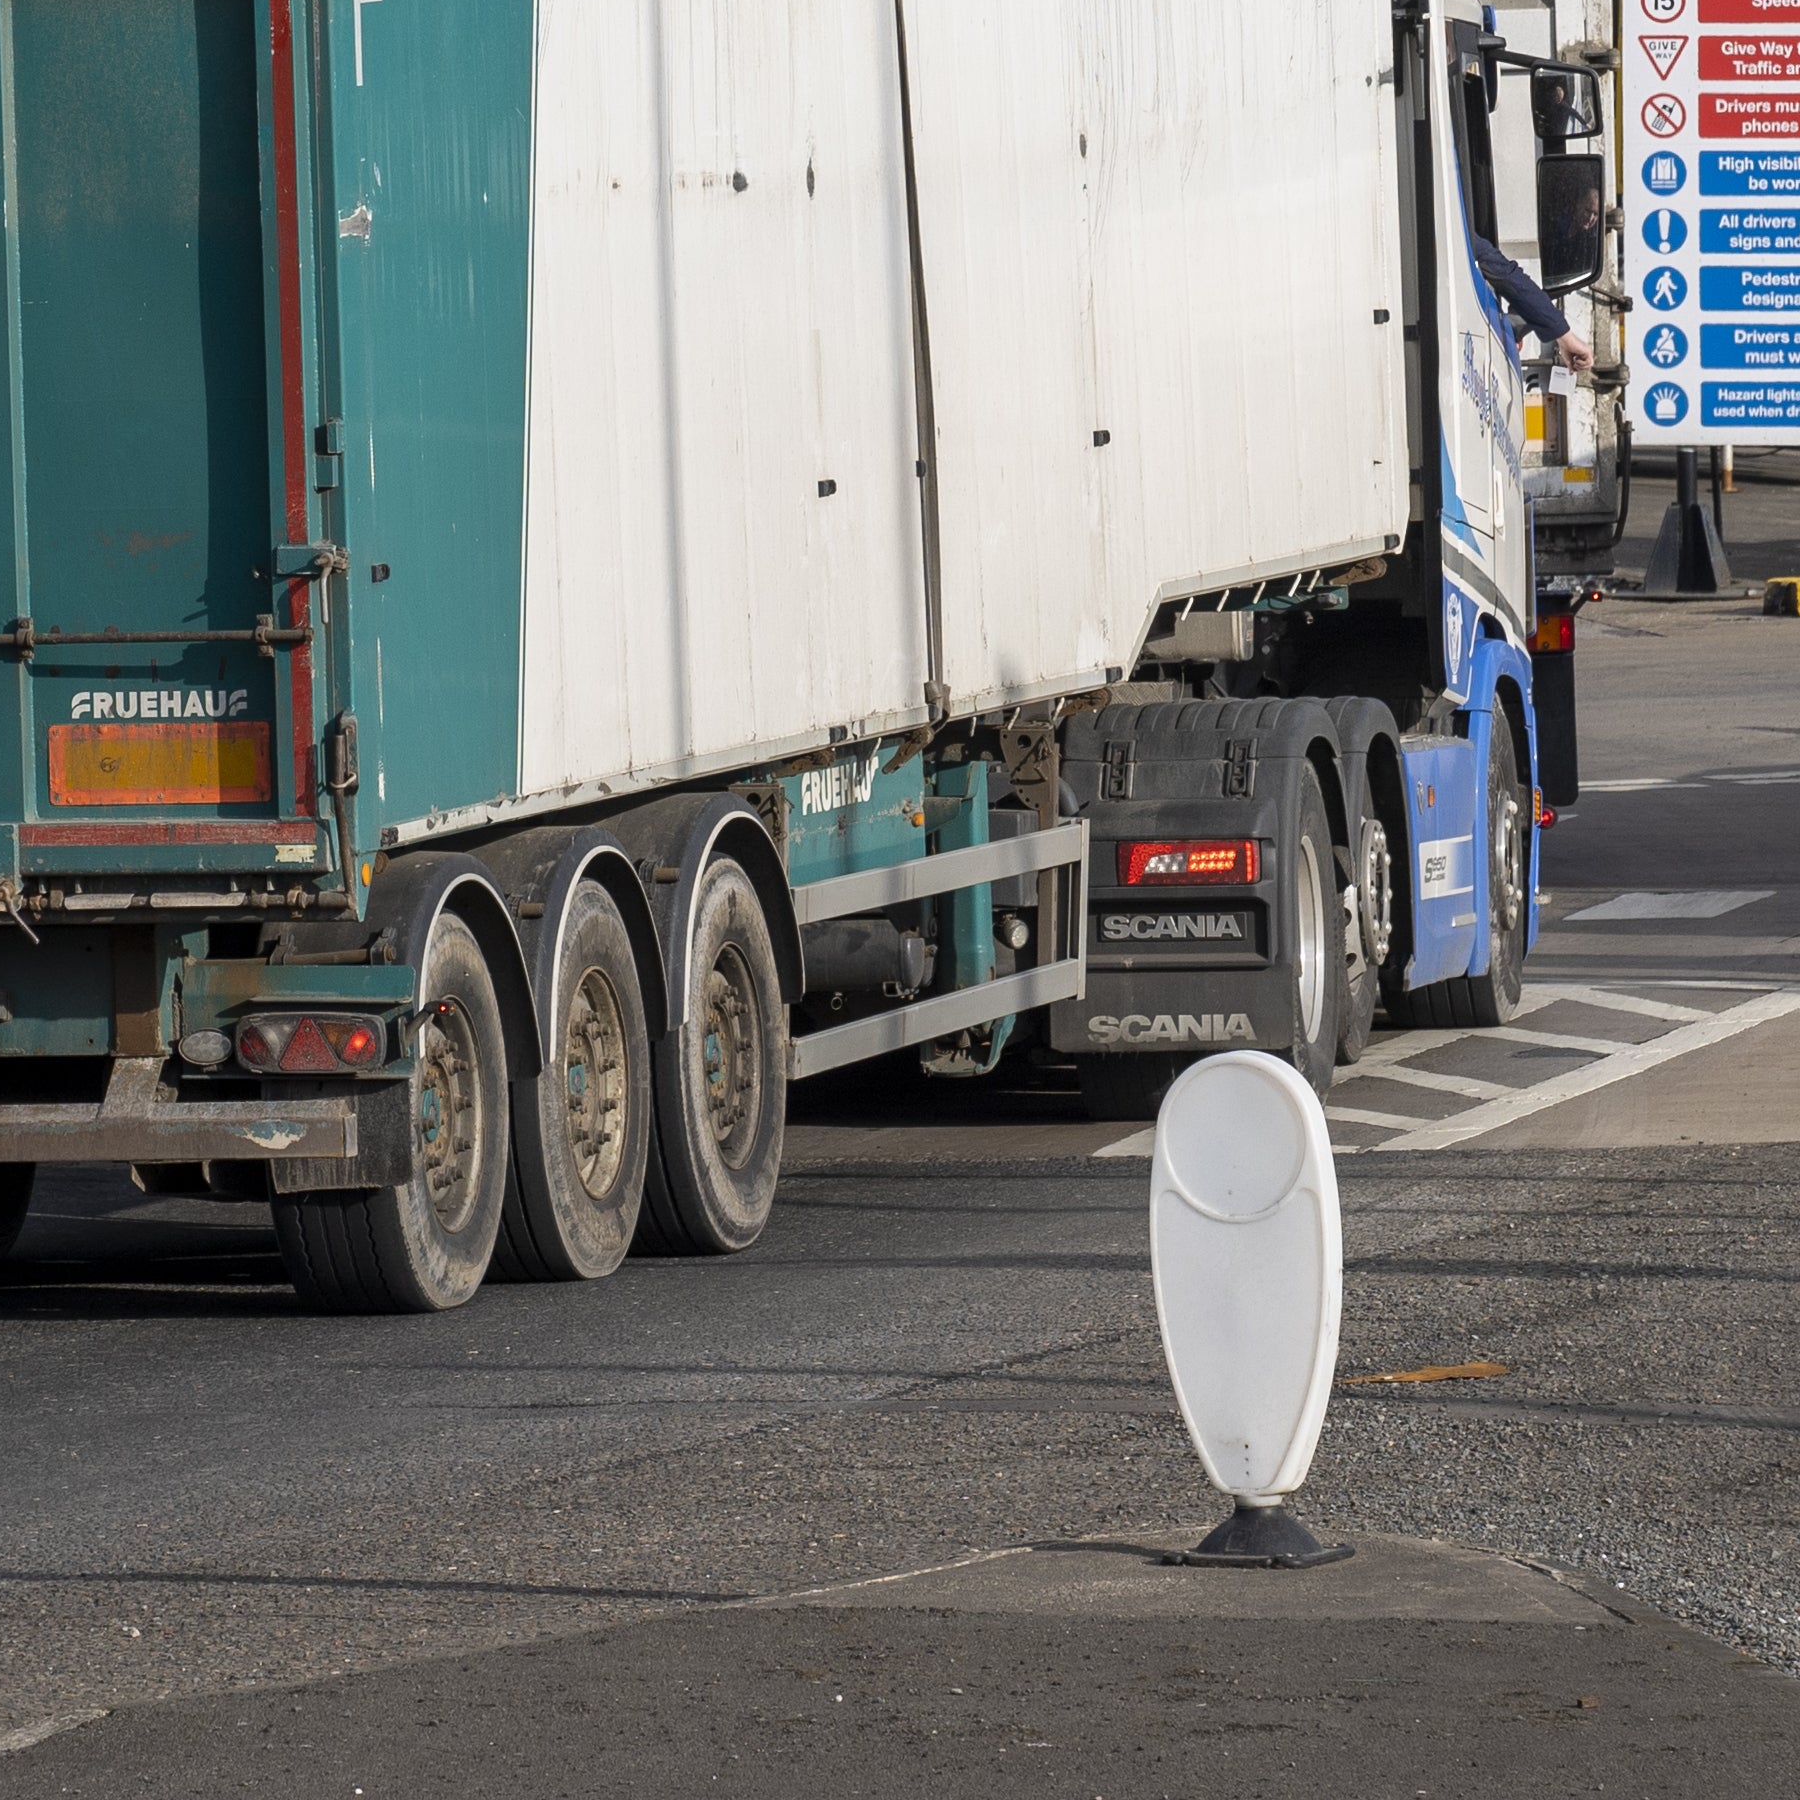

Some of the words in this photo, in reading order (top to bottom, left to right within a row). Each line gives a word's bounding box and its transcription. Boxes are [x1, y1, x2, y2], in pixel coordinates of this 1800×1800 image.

[1648, 41, 1677, 52] GIVE
[1721, 41, 1756, 55] Give
[1759, 41, 1793, 58] Way
[1732, 60, 1782, 75] Traffic
[1715, 98, 1771, 113] Drivers
[1742, 118, 1799, 135] phones
[1718, 156, 1754, 174] High
[1748, 175, 1768, 190] be
[1718, 214, 1739, 228] All
[1742, 214, 1796, 229] drivers
[1730, 234, 1771, 251] signs
[1734, 329, 1790, 344] Drivers
[1745, 350, 1785, 364] must
[71, 689, 248, 720] FRUEHAUF
[1103, 915, 1243, 940] SCANIA
[1087, 1012, 1257, 1043] SCANIA
